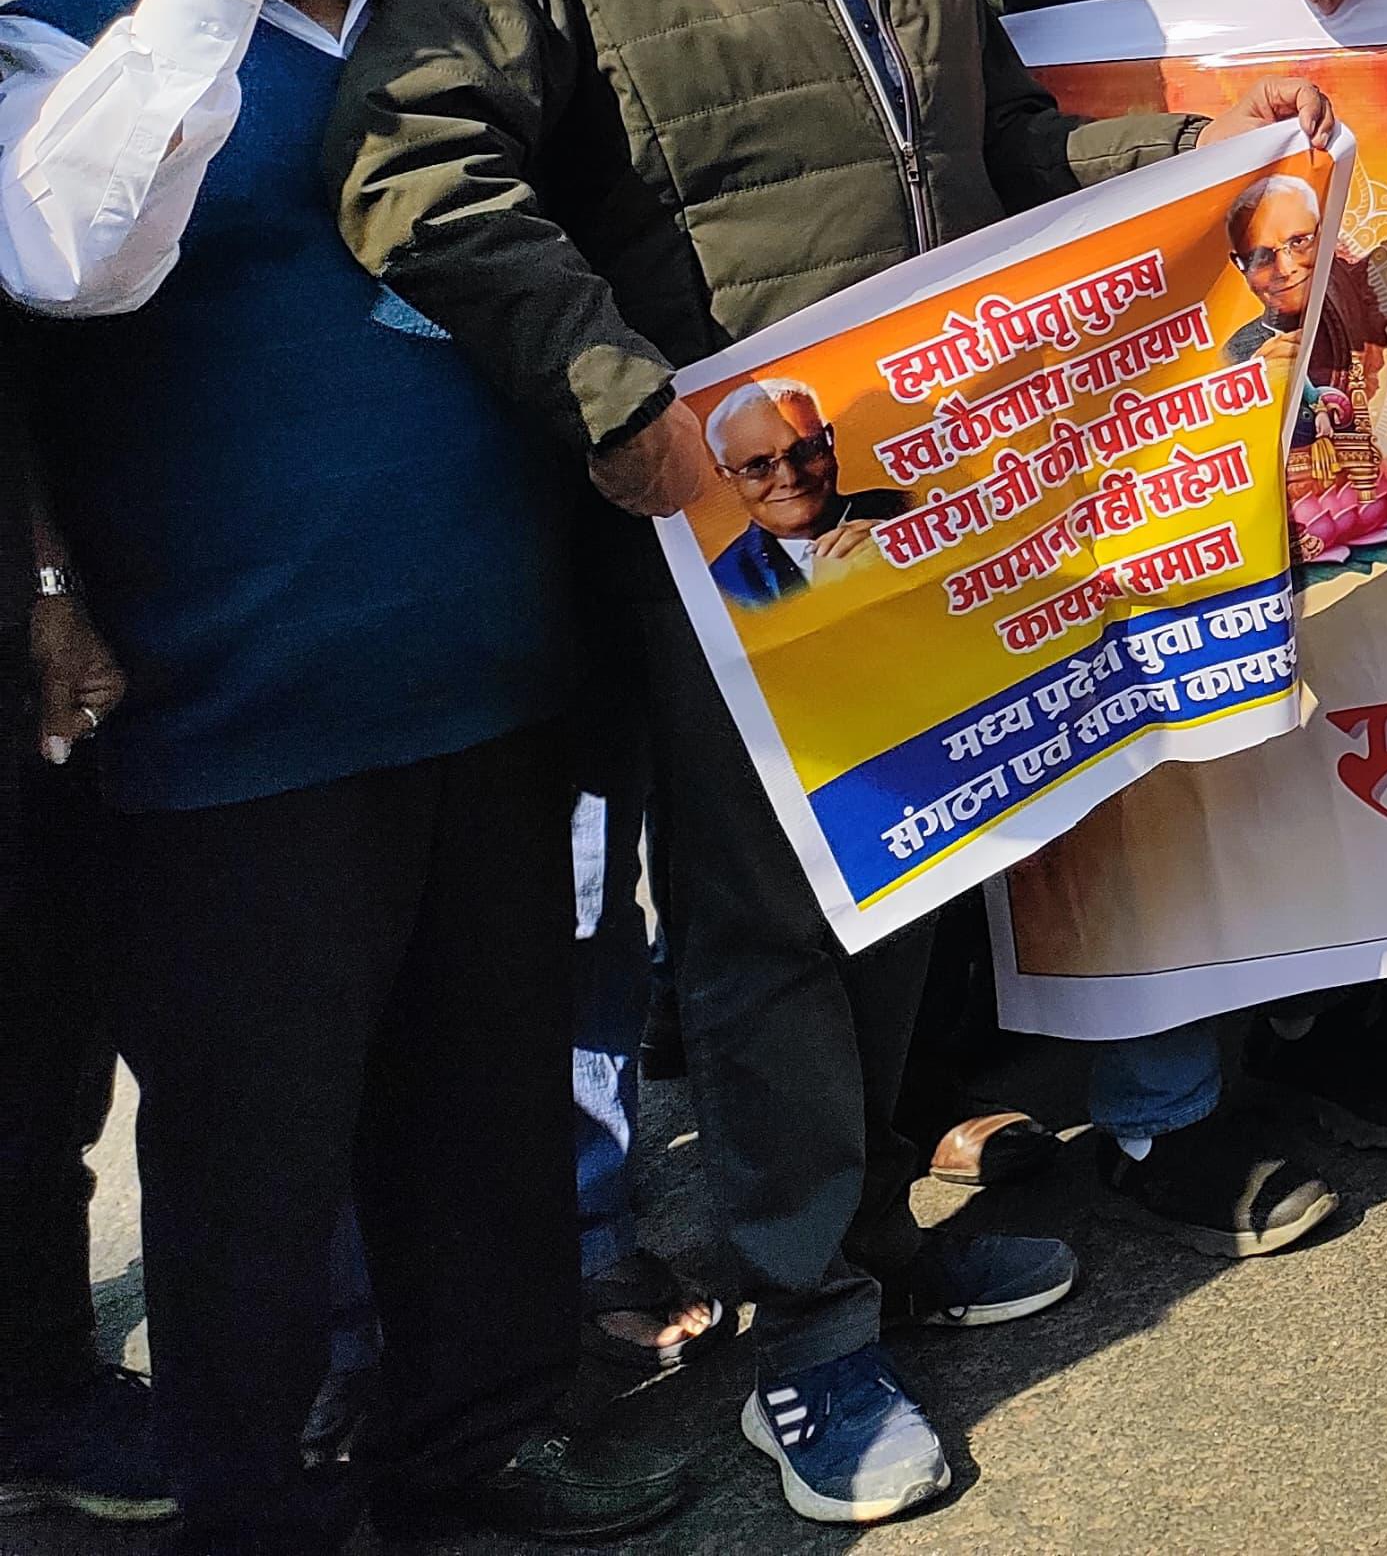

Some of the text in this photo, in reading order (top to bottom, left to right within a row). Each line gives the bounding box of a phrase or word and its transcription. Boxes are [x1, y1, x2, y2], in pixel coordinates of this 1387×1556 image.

[881, 252, 1166, 404] हमारे पितृ पुरुष
[1073, 305, 1210, 395] नारायण
[877, 358, 1270, 567] सारंग जी की प्रतिमा का
[948, 443, 1250, 615] अपमान नहीं सहेगा
[1114, 524, 1241, 596] समाज
[883, 761, 1008, 862] संगठन
[1010, 722, 1074, 800] एवं
[1076, 674, 1179, 749] सकल
[942, 701, 1030, 768] मध्य
[1033, 649, 1119, 725] प्रदेश
[1122, 615, 1202, 676] युवा
